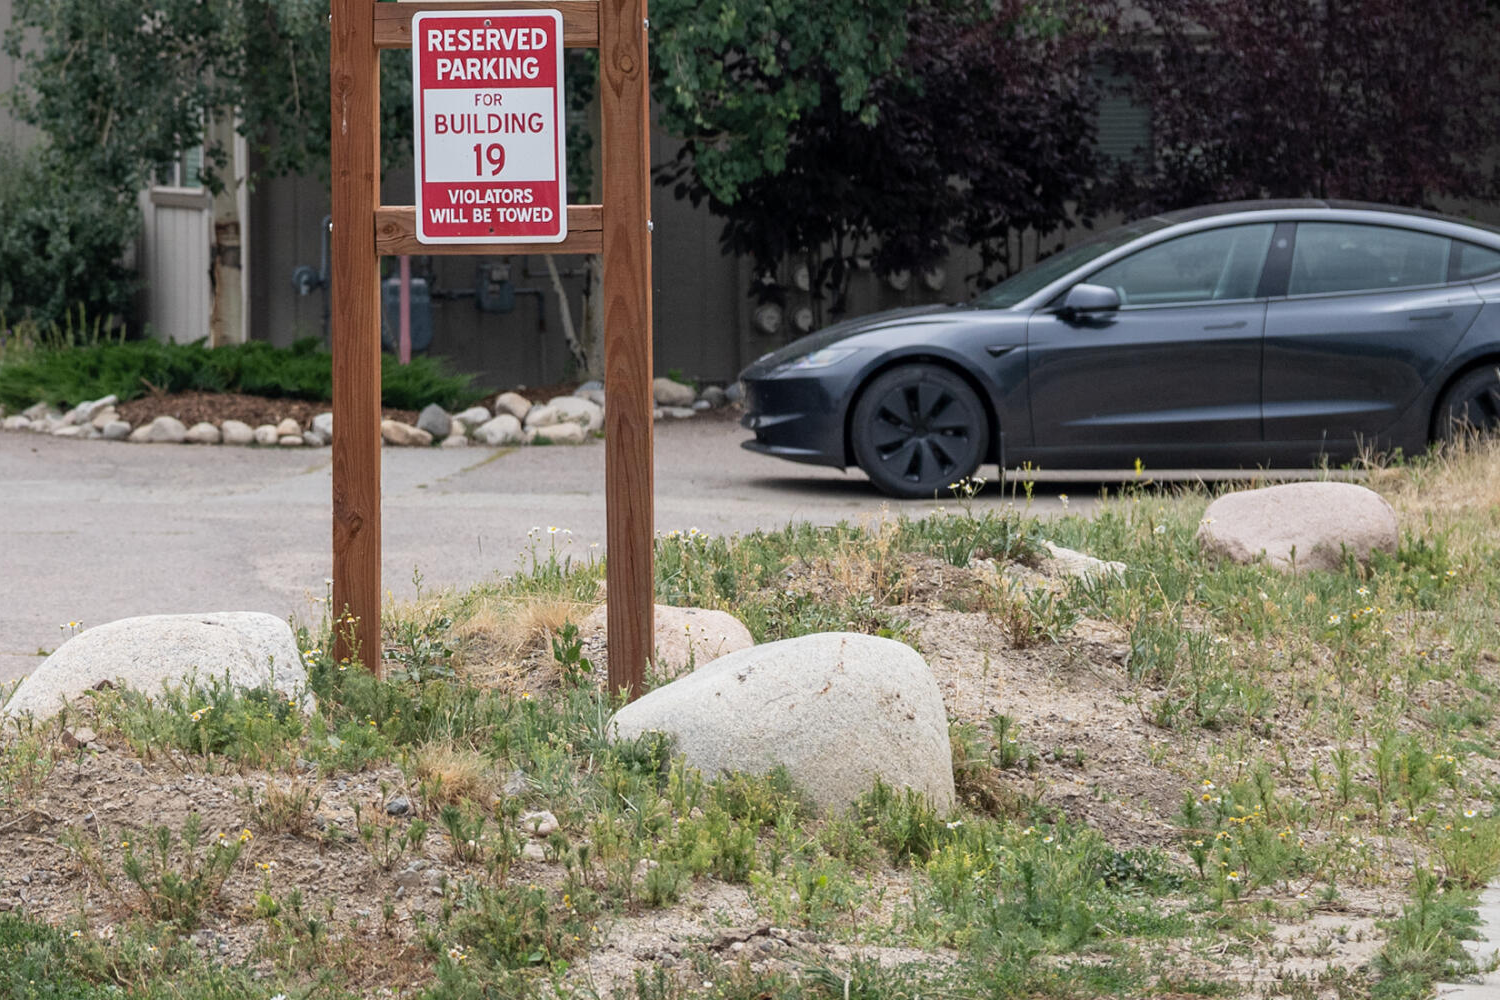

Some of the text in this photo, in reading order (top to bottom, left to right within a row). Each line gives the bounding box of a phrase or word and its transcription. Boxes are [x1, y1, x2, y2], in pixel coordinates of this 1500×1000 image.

[427, 28, 548, 52] RESERVED
[436, 57, 540, 81] PARKING
[474, 93, 503, 107] FOR
[434, 112, 544, 135] BUILDING
[473, 143, 506, 176] 19
[448, 188, 534, 205] VIOLATORS
[429, 207, 553, 224] WILL BE TOWED
